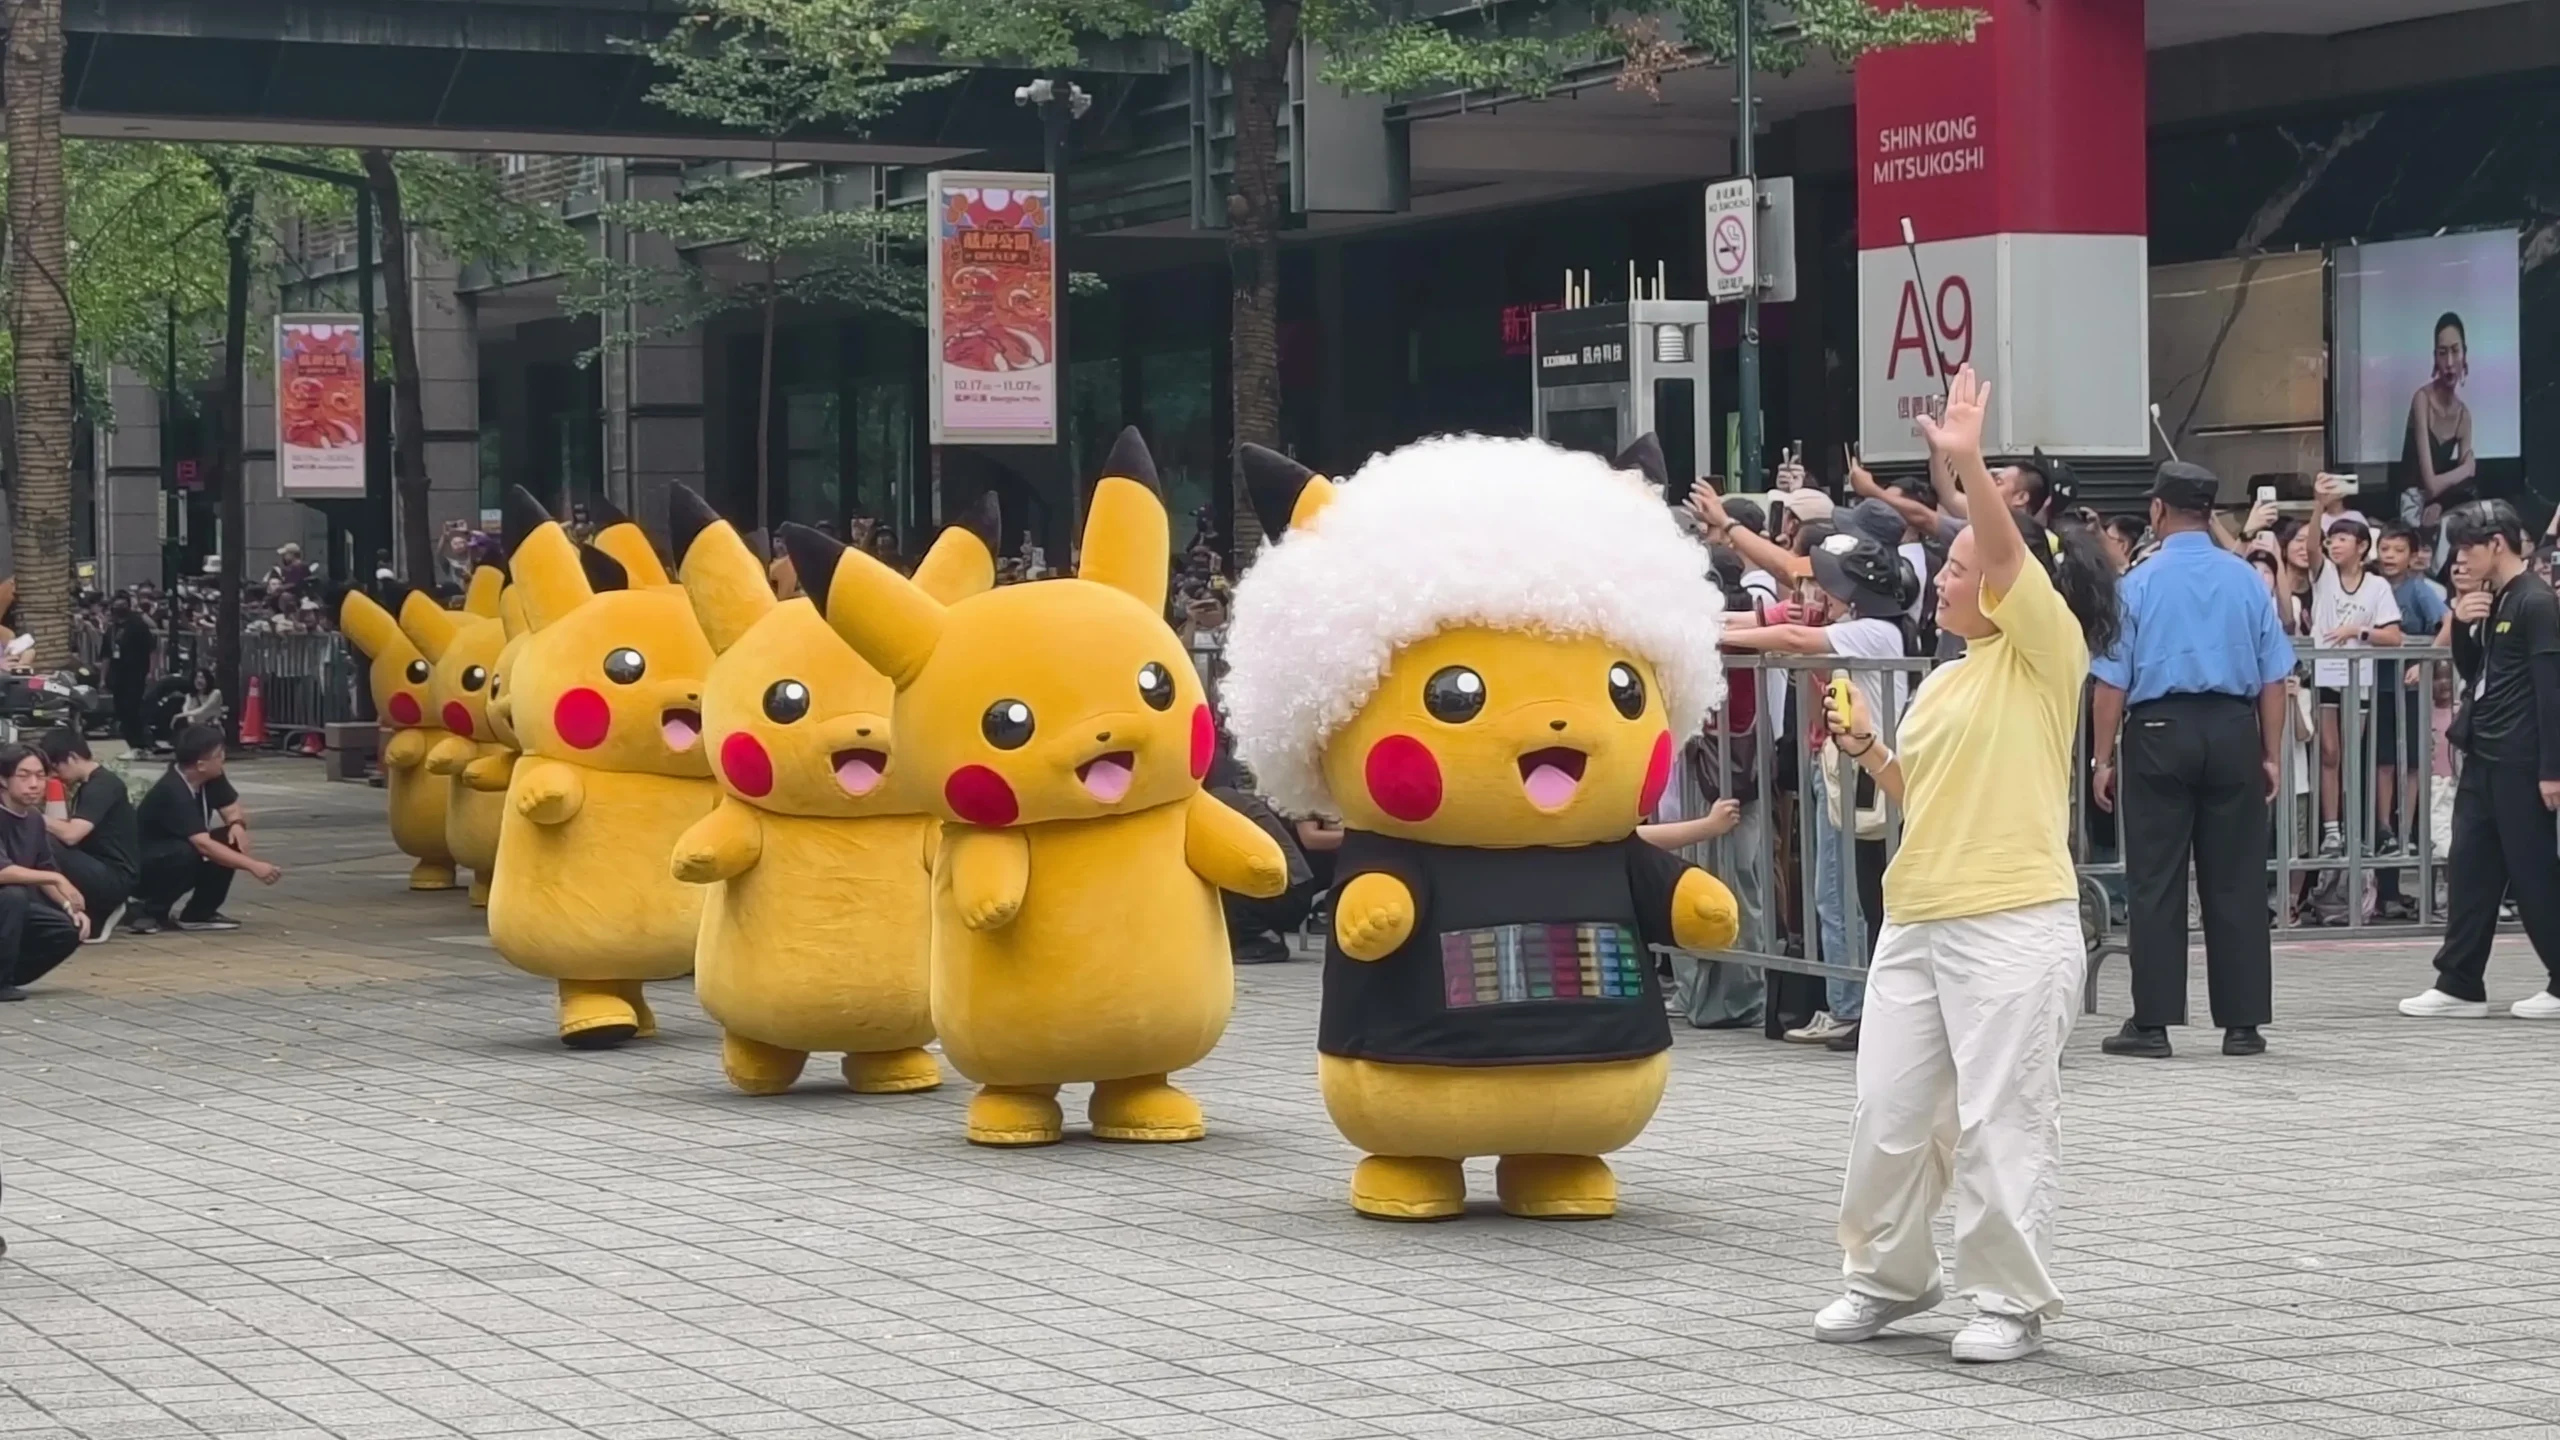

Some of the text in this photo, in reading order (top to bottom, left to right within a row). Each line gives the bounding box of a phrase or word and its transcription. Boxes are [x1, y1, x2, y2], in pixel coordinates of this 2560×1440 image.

[1880, 115, 1977, 153] SHIN KONG
[1873, 146, 1984, 185] MITSUKOSHI
[1887, 275, 1972, 380] A9
[954, 380, 982, 391] 10.17
[1003, 380, 1032, 391] 11.07
